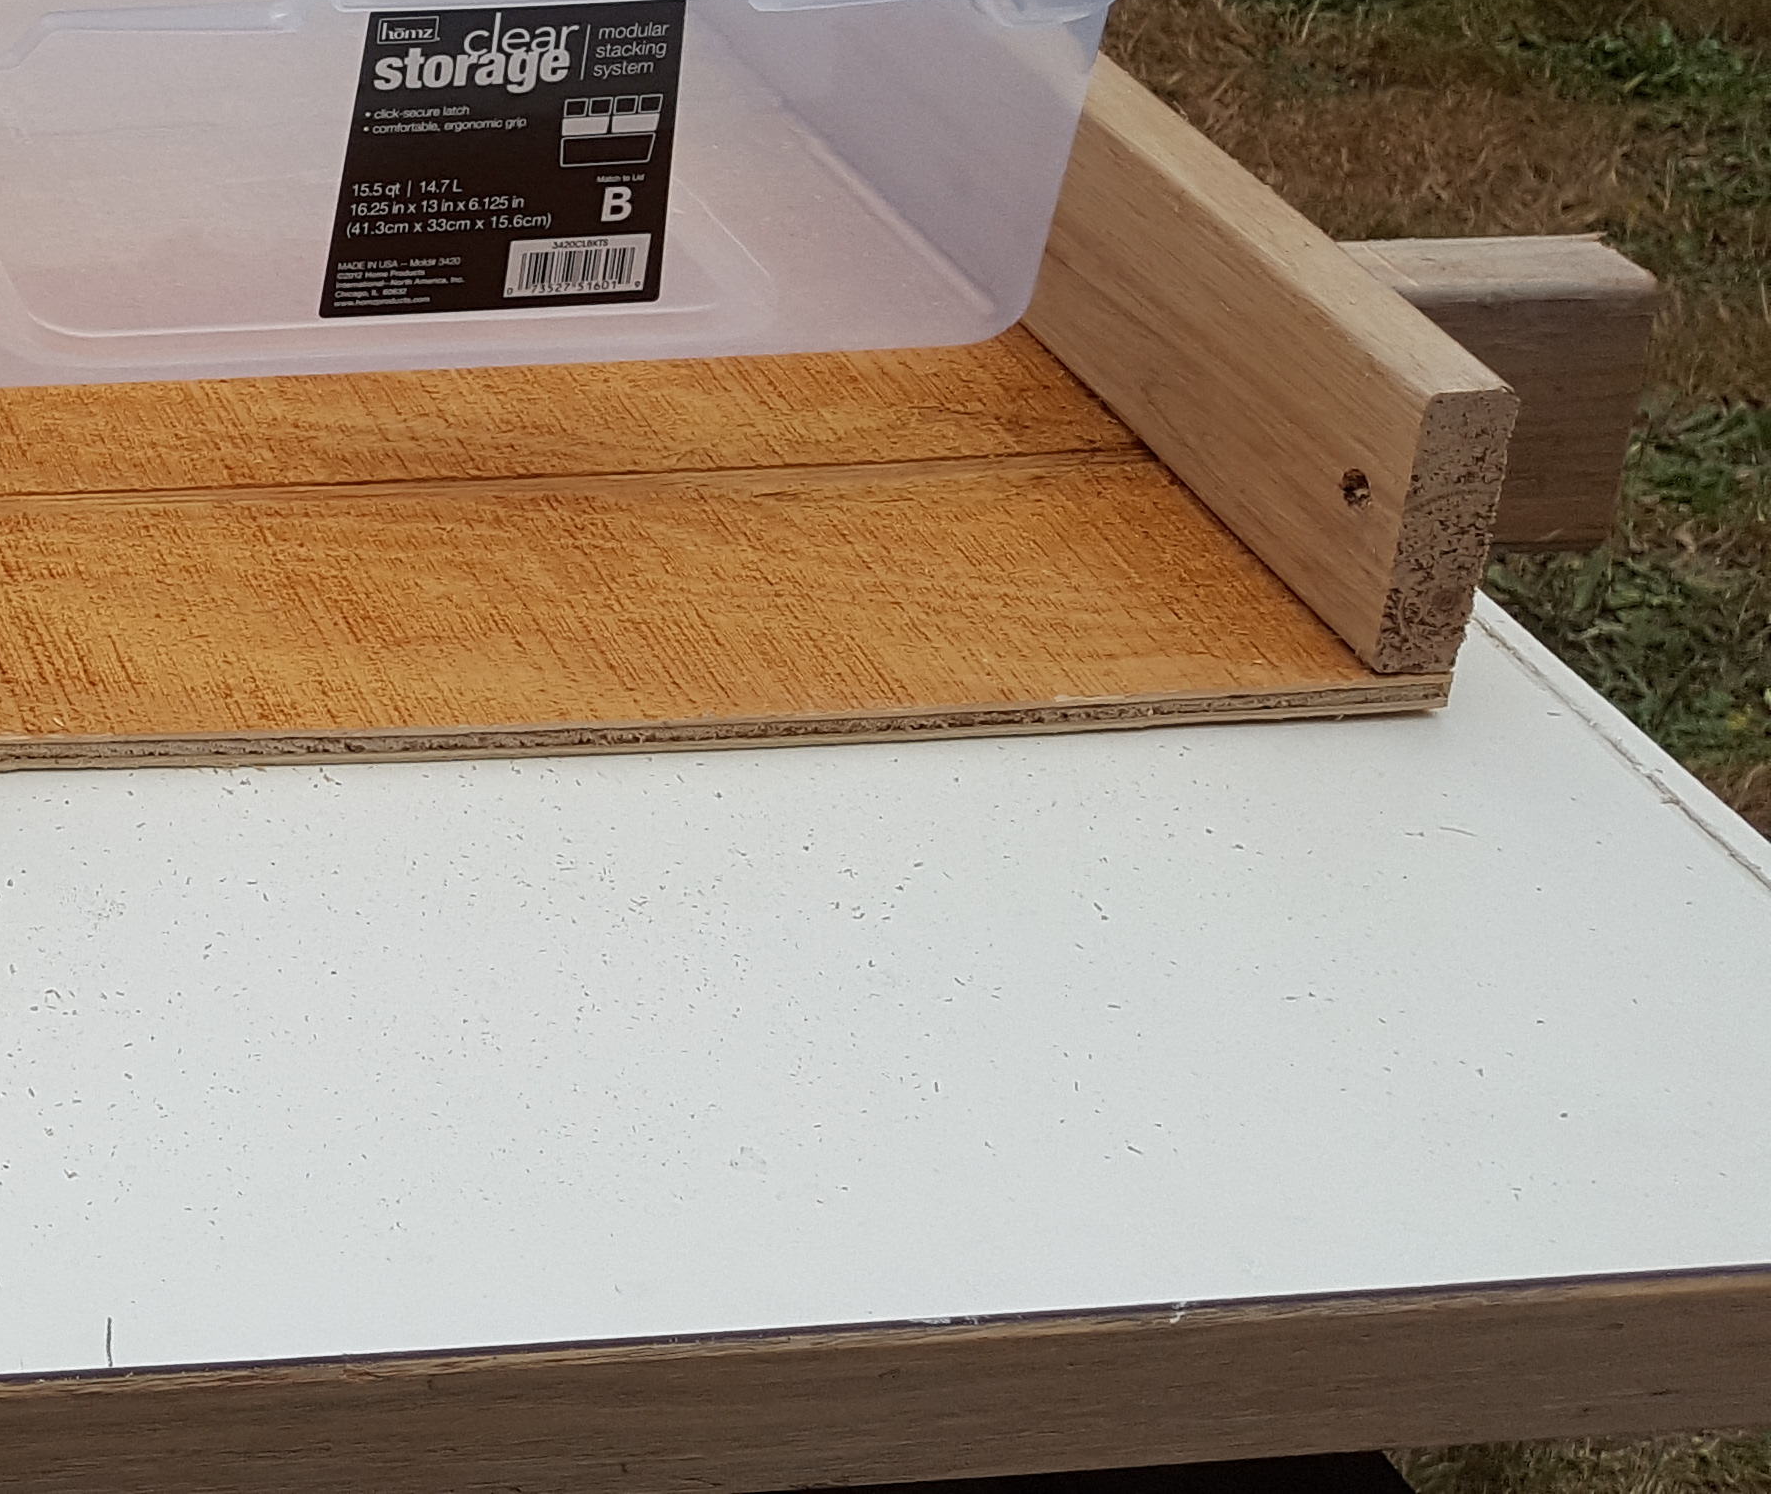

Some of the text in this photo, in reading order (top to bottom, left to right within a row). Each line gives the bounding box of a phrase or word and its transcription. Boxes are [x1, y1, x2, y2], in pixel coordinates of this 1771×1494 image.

[463, 12, 580, 55] clear
[598, 22, 670, 40] modular
[595, 40, 667, 58] stacking
[373, 47, 571, 94] storage
[593, 61, 654, 79] system
[373, 105, 470, 120] click-secure latch
[372, 116, 527, 134] comfortable, ergonomic grip
[596, 173, 646, 183] Match to Lid
[351, 183, 383, 197] 15.5
[385, 183, 401, 199] qt
[419, 180, 449, 194] 14.7
[452, 179, 463, 193] L
[350, 195, 525, 217] 16.25 in x 13 in x 6.125 in
[600, 186, 633, 222] B
[346, 212, 553, 239] (41.3cm x 33cm x 15.6cm)
[337, 261, 366, 271] MADE
[367, 260, 377, 269] IN
[379, 259, 399, 269] USA
[531, 283, 571, 294] 73527
[578, 280, 617, 291] 51601
[634, 280, 641, 289] 9
